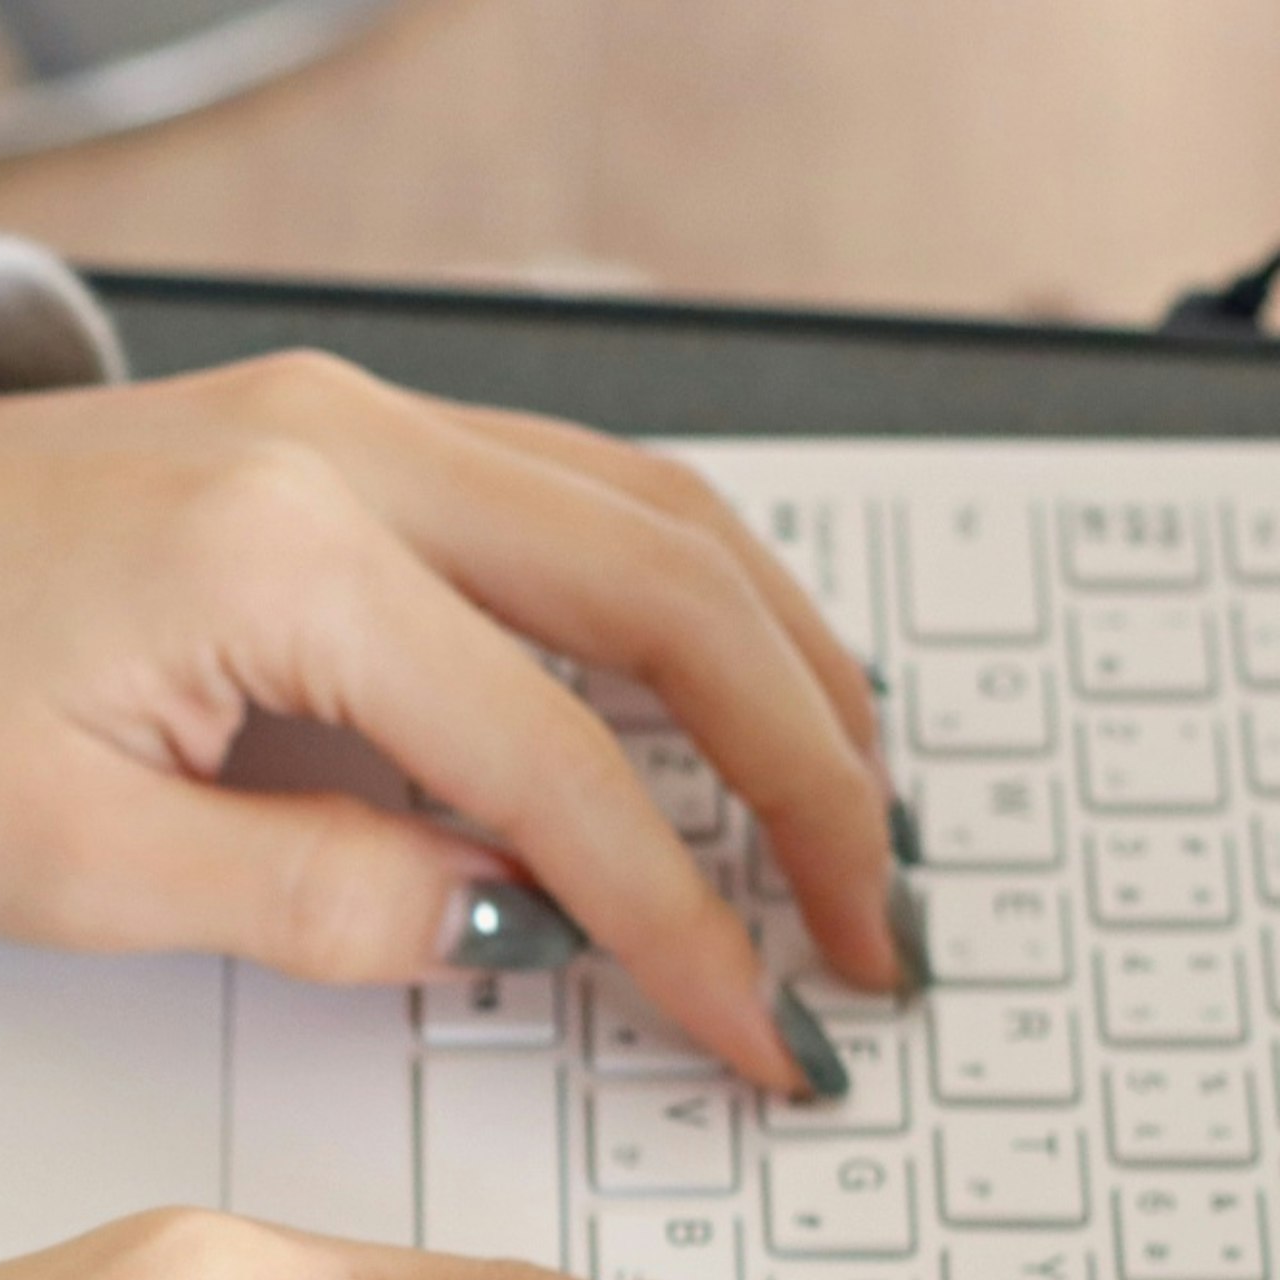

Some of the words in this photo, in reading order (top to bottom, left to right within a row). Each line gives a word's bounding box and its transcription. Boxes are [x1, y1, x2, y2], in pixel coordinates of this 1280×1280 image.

[1009, 1008, 1052, 1041] R
[664, 1096, 712, 1129] V
[1011, 1131, 1061, 1159] T
[836, 1156, 888, 1193] G
[1136, 1189, 1177, 1214] 6
[664, 1218, 714, 1247] B
